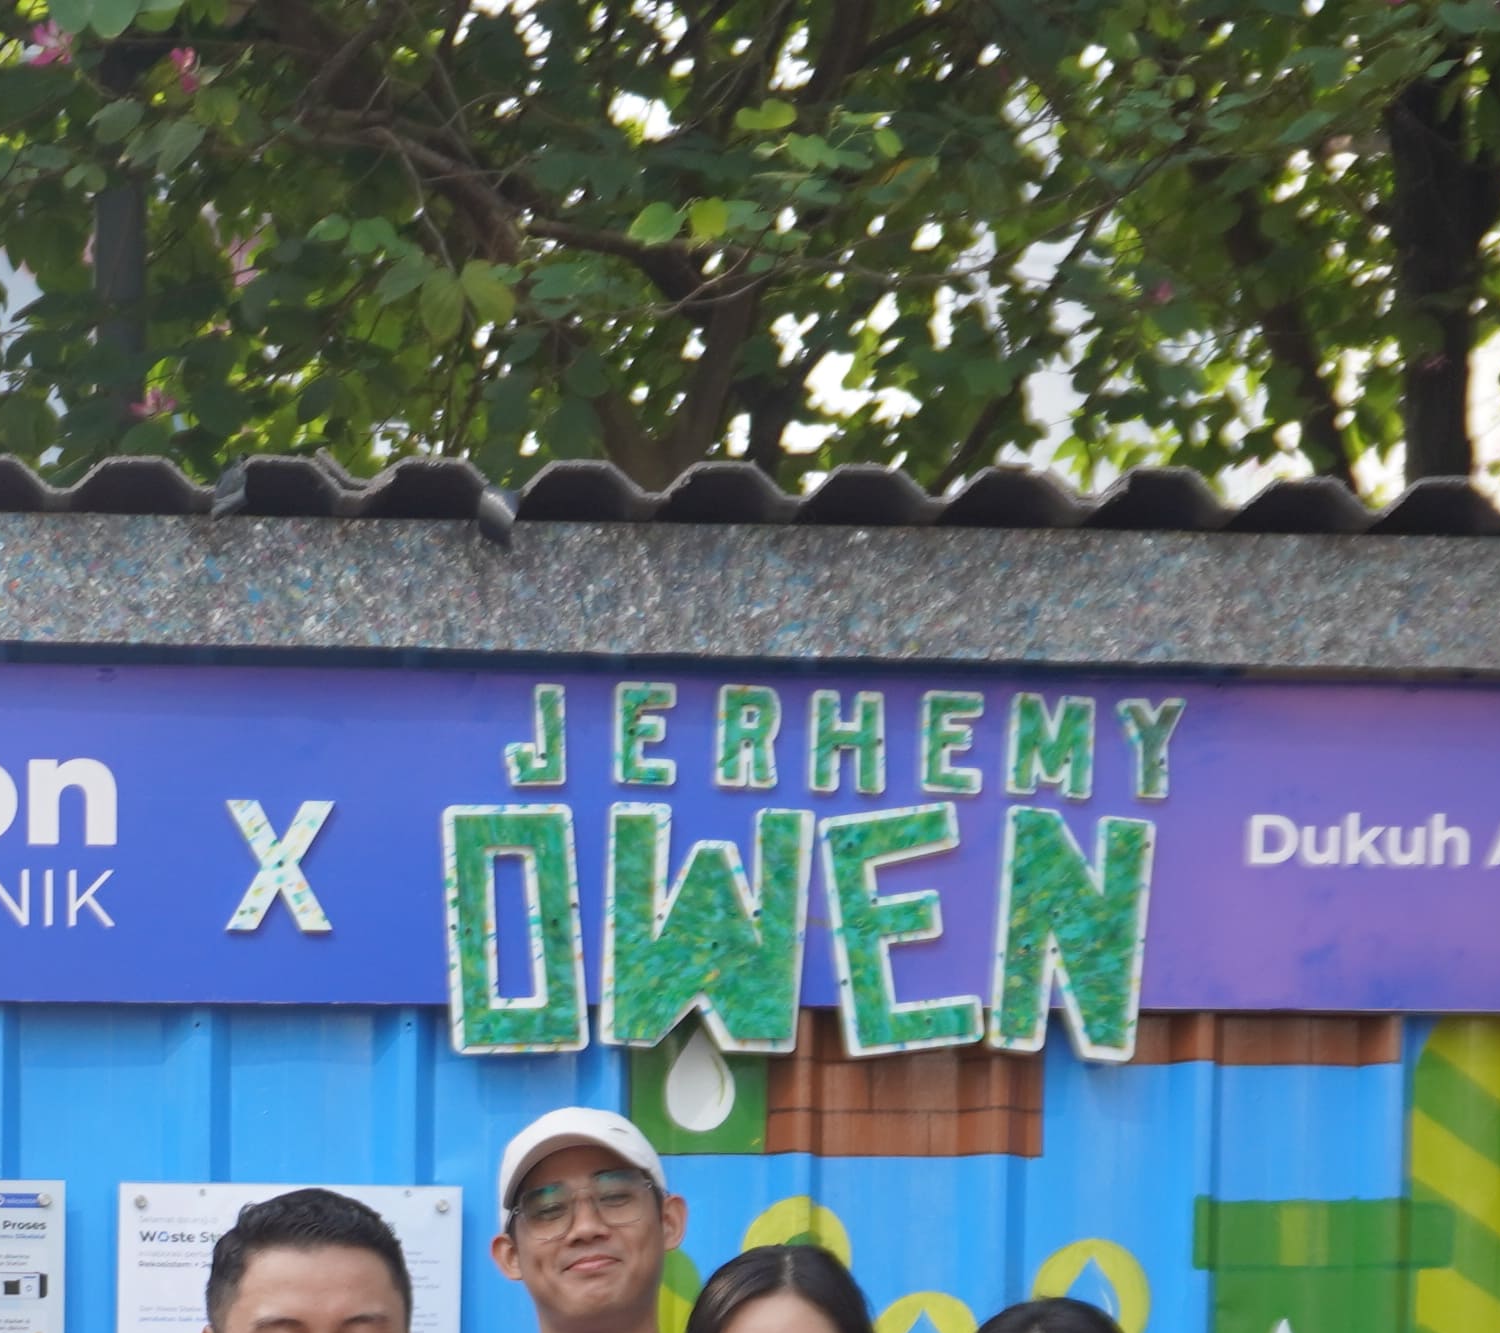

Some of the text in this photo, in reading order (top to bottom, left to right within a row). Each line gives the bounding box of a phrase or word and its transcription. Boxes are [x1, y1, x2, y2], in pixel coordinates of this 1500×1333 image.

[505, 681, 1187, 800] JERHEMY
[226, 798, 333, 935] X
[1247, 812, 1467, 868] Dukuh
[443, 801, 1155, 1064] OWEN
[3, 1220, 47, 1230] Proses
